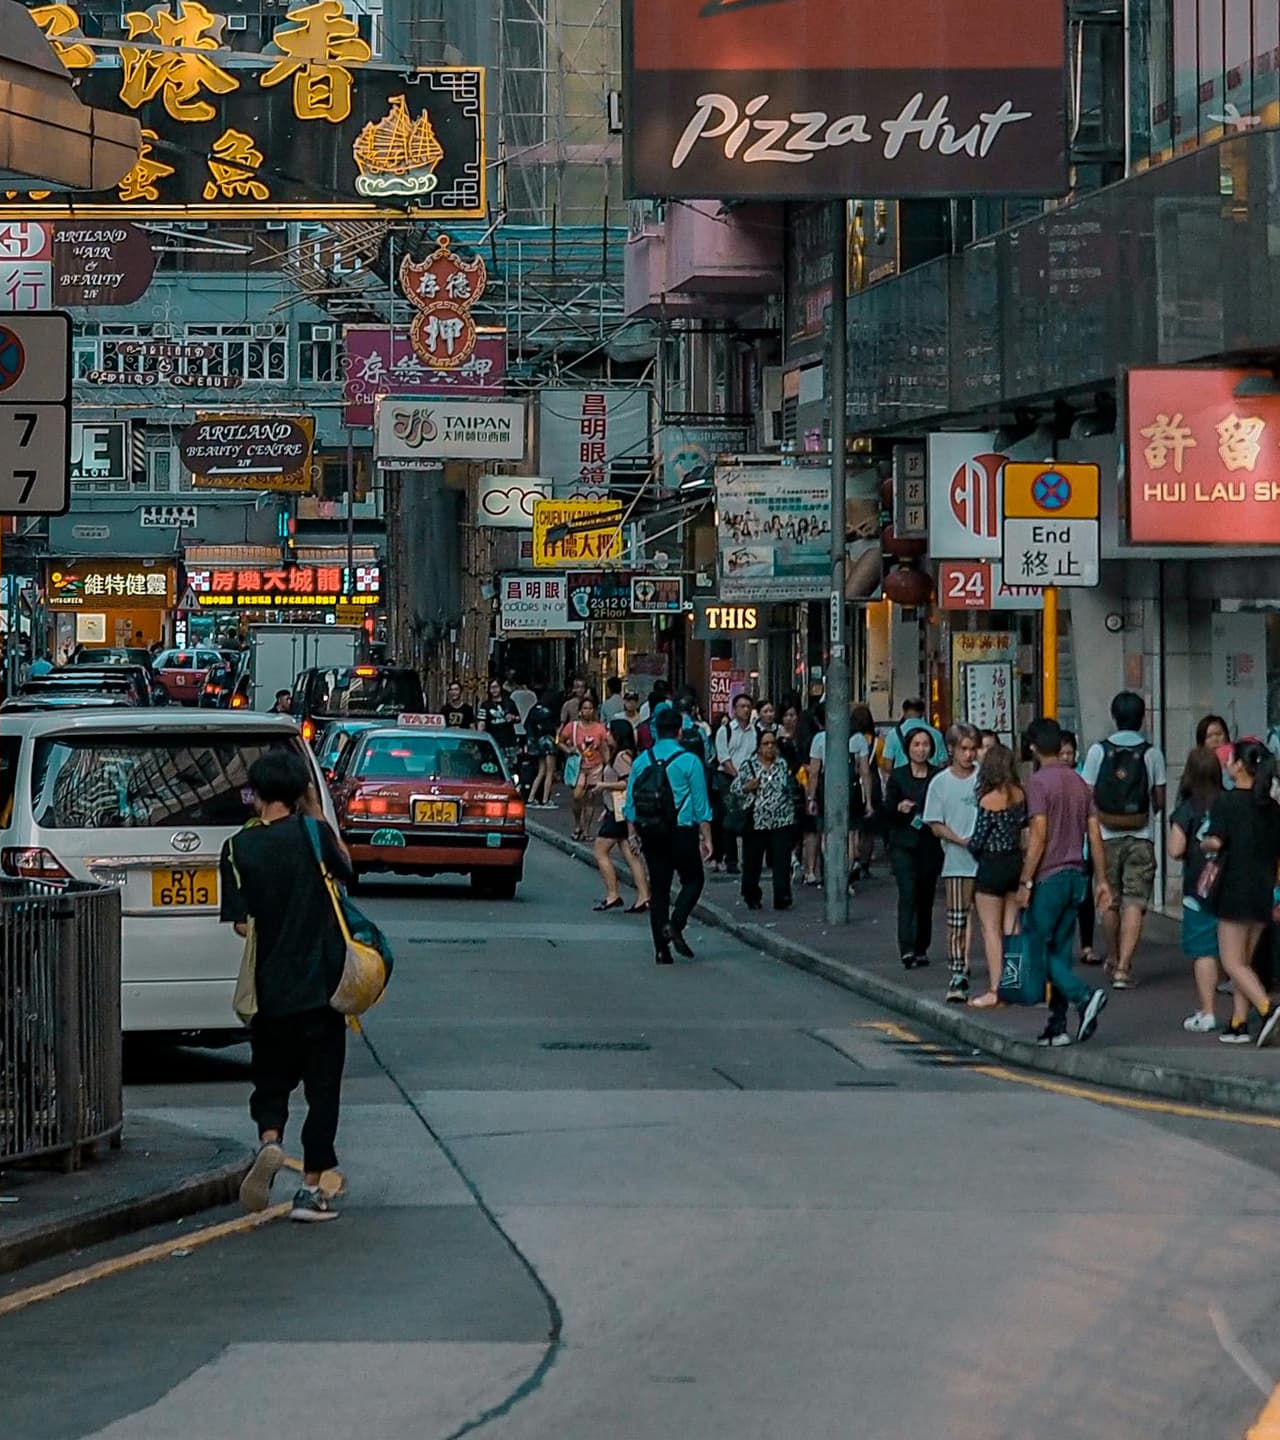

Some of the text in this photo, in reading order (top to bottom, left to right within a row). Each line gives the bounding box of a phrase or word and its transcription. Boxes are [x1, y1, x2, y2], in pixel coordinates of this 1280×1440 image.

[671, 91, 1033, 169] Pizza Hut
[55, 230, 127, 242] ARTLAND
[73, 246, 113, 260] HAIR
[60, 274, 125, 287] BEAUTY
[423, 316, 465, 356] 押
[14, 414, 38, 447] 7
[197, 423, 291, 440] ARTLAND
[443, 416, 511, 430] TAIPAN
[580, 394, 608, 485] 昌明眼鏡
[186, 443, 304, 458] BEAUTY CENTRE
[72, 469, 110, 477] ALON
[13, 471, 37, 504] 7
[1143, 481, 1186, 503] HUI
[1194, 480, 1246, 502] LAU
[1032, 526, 1071, 544] End
[1022, 550, 1081, 577] 終止
[83, 573, 168, 596] 維特健靈
[507, 581, 567, 599] 昌明眼
[948, 571, 985, 597] 24
[705, 607, 757, 629] THIS
[401, 714, 442, 726] TAXI
[171, 869, 198, 889] RY
[160, 887, 210, 907] 6513
